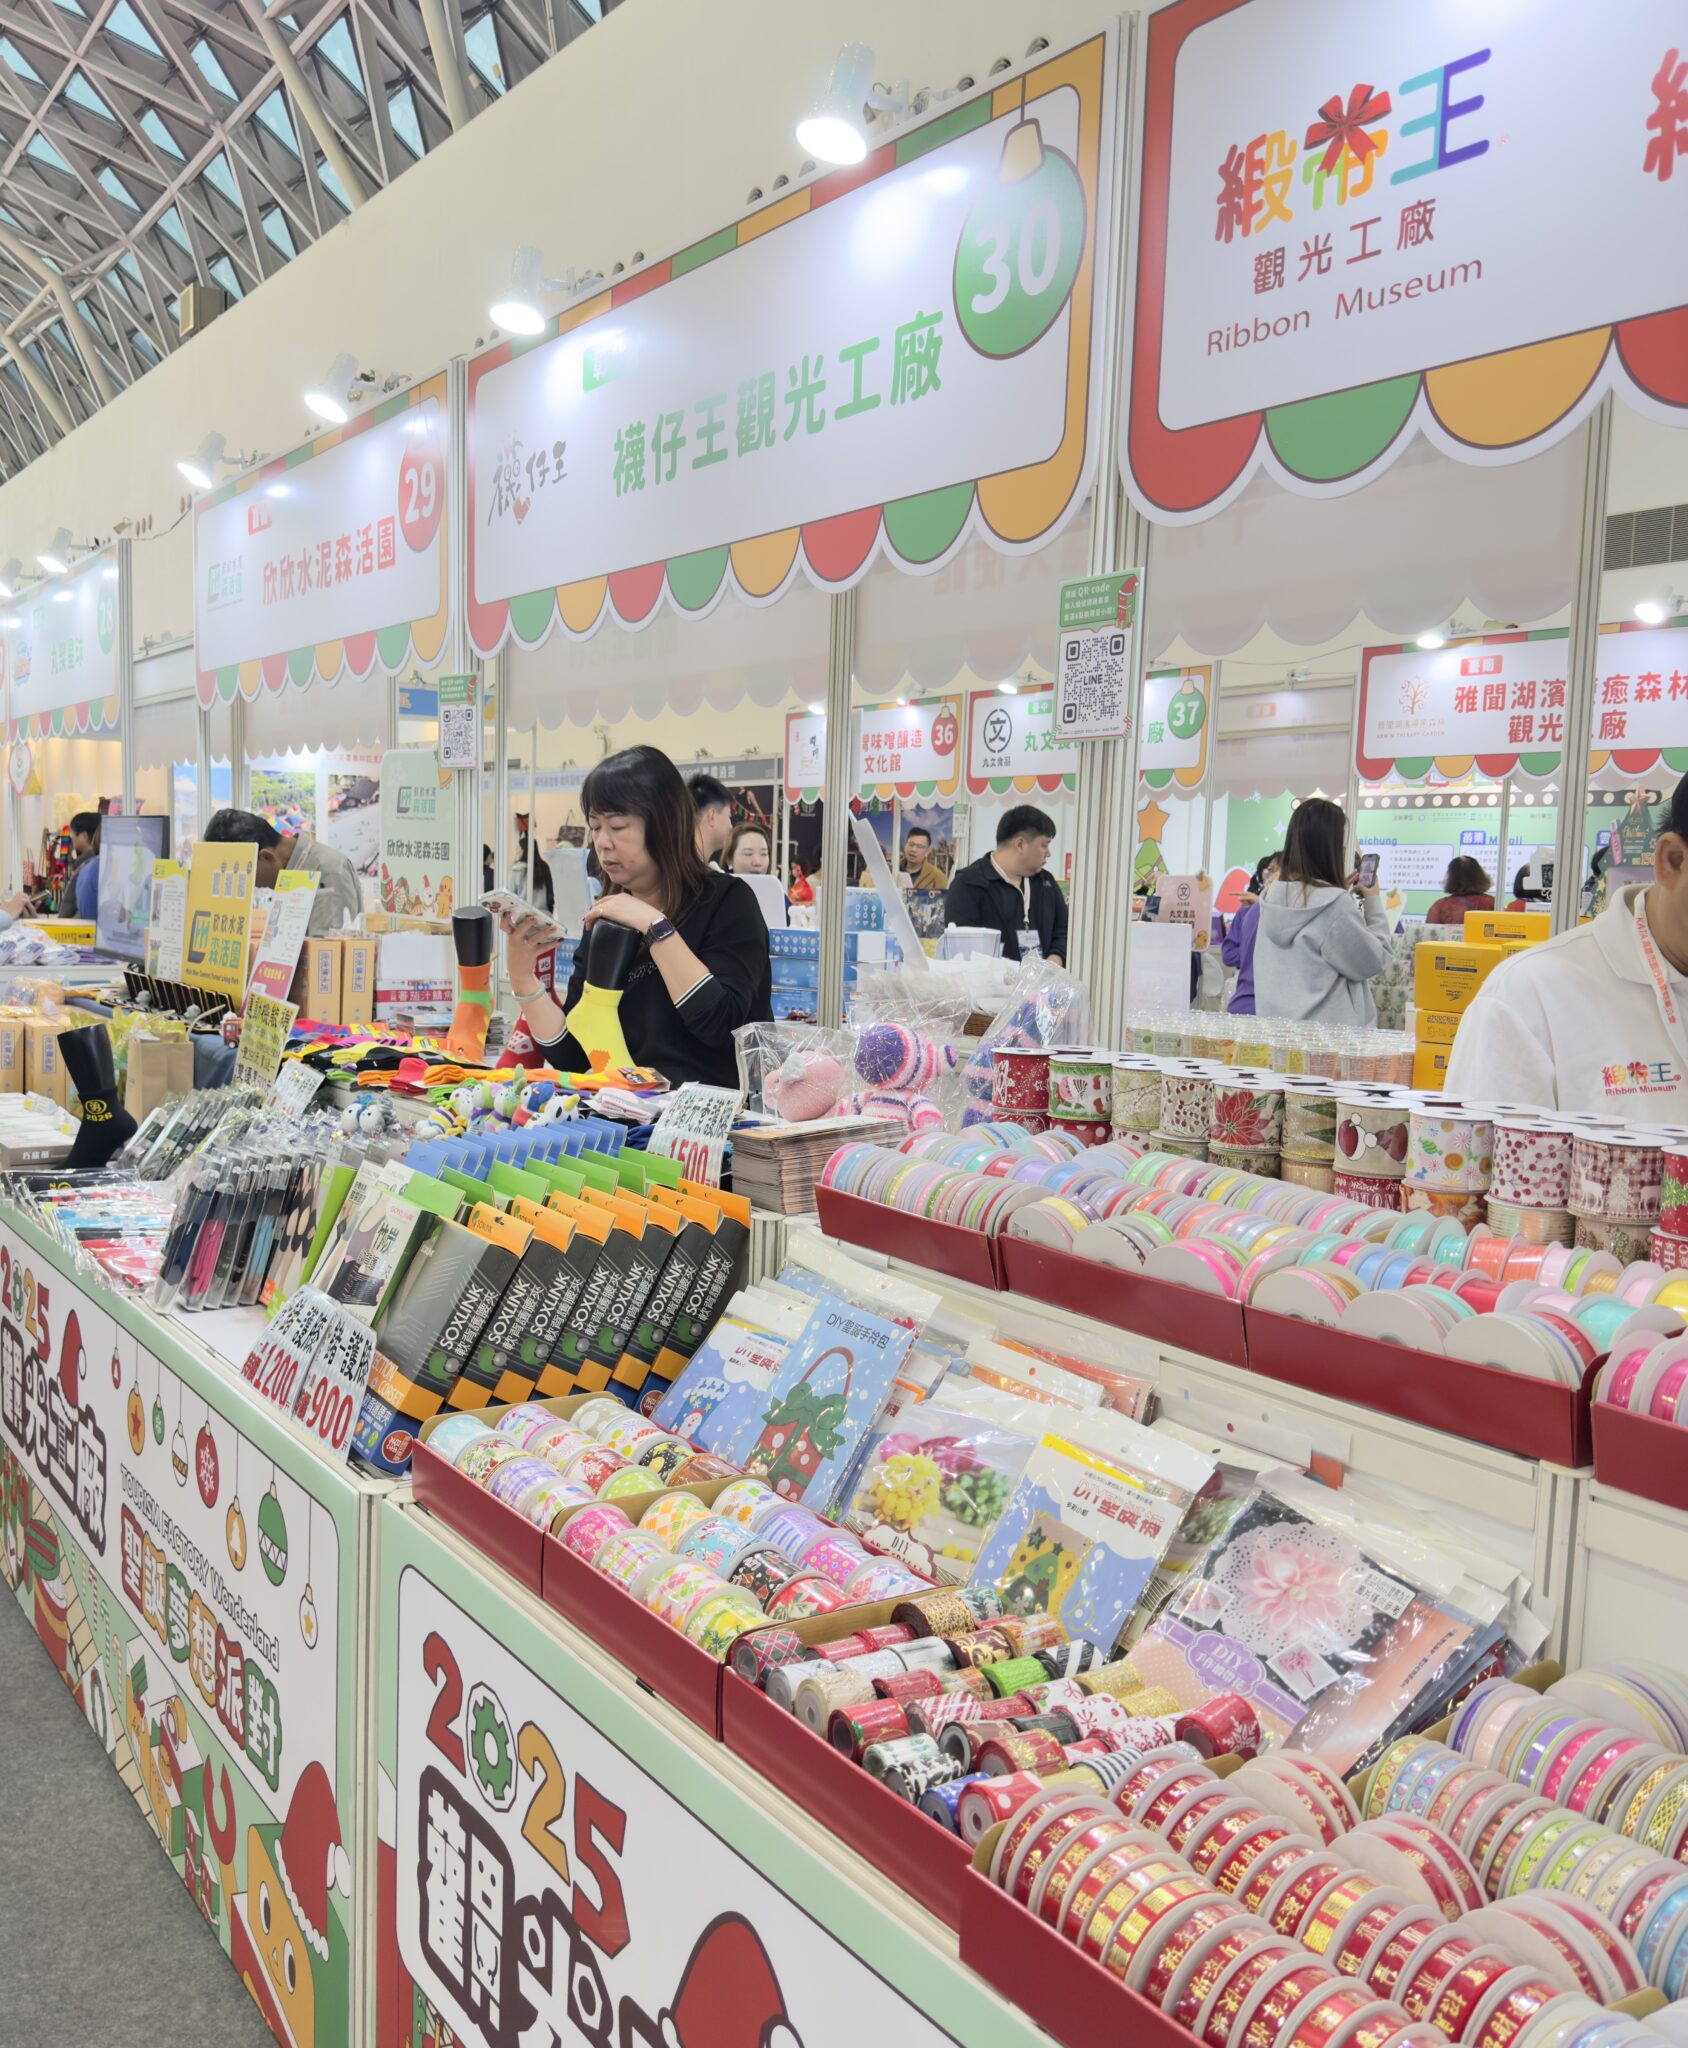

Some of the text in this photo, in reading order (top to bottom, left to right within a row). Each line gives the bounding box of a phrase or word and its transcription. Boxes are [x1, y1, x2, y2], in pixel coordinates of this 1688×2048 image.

[972, 205, 1061, 315] 30
[1253, 198, 1437, 295] 觀光工廠
[1207, 259, 1483, 356] Ribbon Museum
[613, 310, 943, 498] 襪仔王觀光工廠
[404, 467, 435, 525] 29
[262, 514, 396, 607] 欣欣水泥森活園
[1078, 586, 1089, 596] QR
[1091, 582, 1110, 594] code
[1083, 674, 1103, 686] LINE
[934, 723, 954, 746] 36
[1172, 700, 1200, 727] 37
[864, 753, 902, 774] 文化館
[1605, 1083, 1677, 1097] Ribbon Museum
[440, 1283, 484, 1350] SOXLINK
[488, 1278, 530, 1344] SOXLINK
[530, 1271, 570, 1336] SOXLINK
[571, 1266, 610, 1331] SOXLINK
[607, 1261, 645, 1326] SOXLINK
[647, 1259, 685, 1322] SOXLINK
[686, 1253, 722, 1316] SOXLINK
[121, 1463, 280, 1673] TOURISM FACTORY Wonderland
[891, 1535, 911, 1555] DIY
[121, 1504, 280, 1793] 聖誕夢想派對
[1214, 1643, 1248, 1671] DIY
[423, 1631, 632, 1960] 2025
